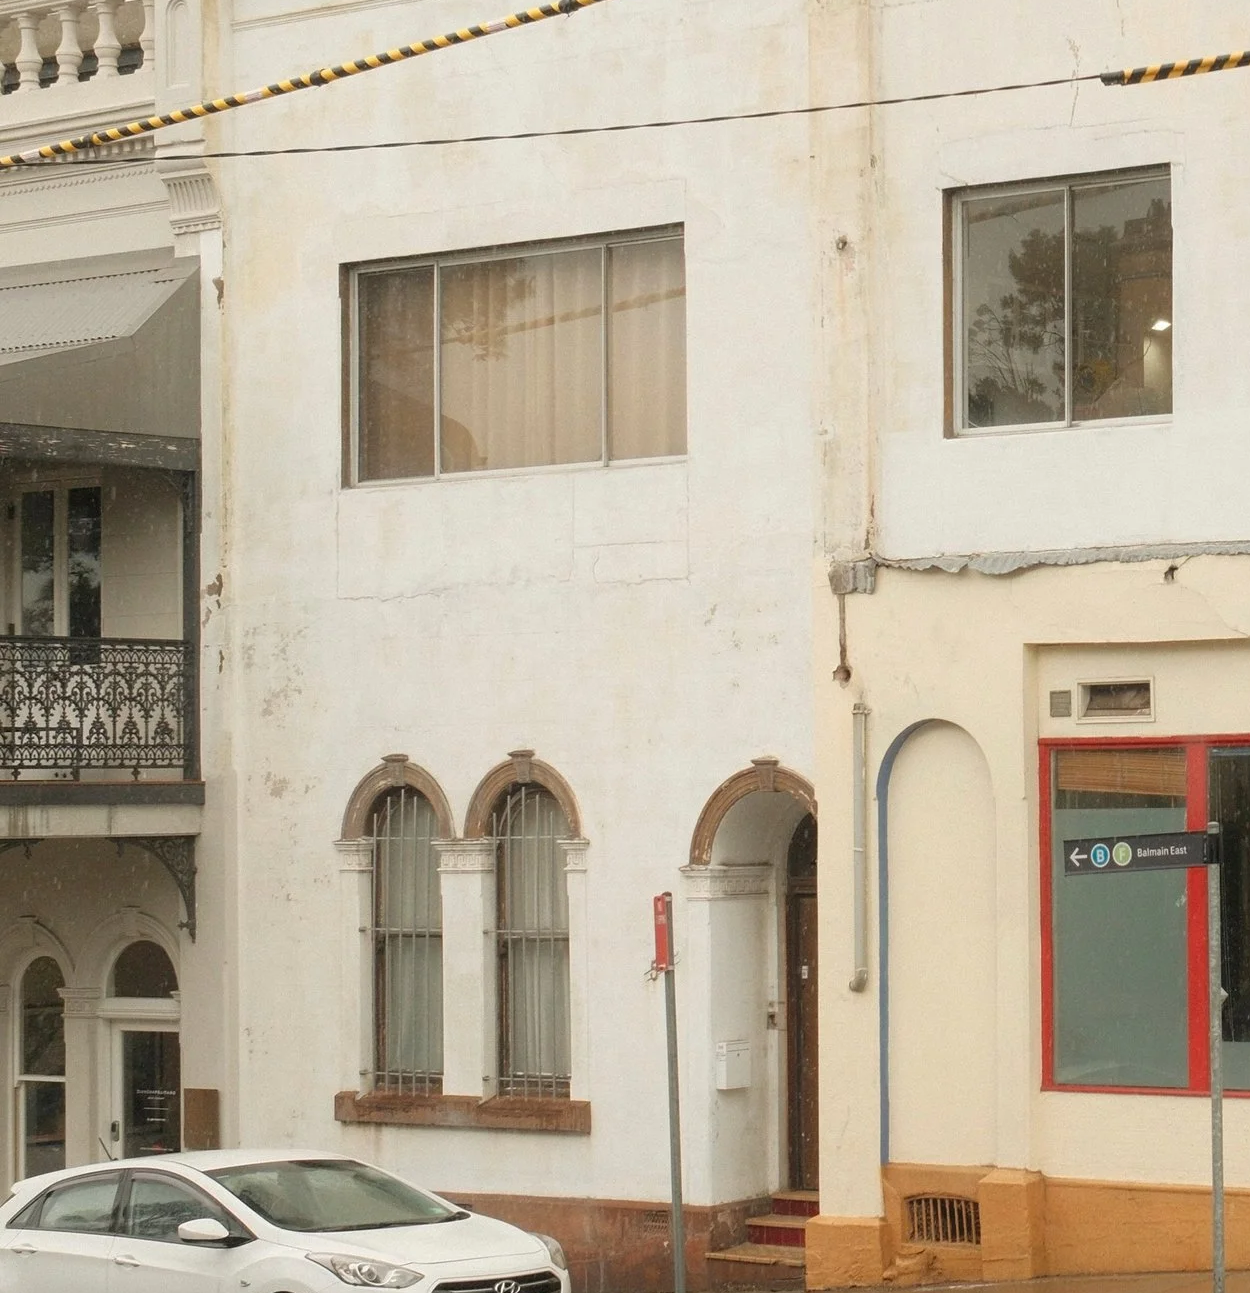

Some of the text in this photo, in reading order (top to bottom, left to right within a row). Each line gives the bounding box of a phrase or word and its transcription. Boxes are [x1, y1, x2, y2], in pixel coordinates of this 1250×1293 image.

[1096, 845, 1188, 863] B F Balmain East
